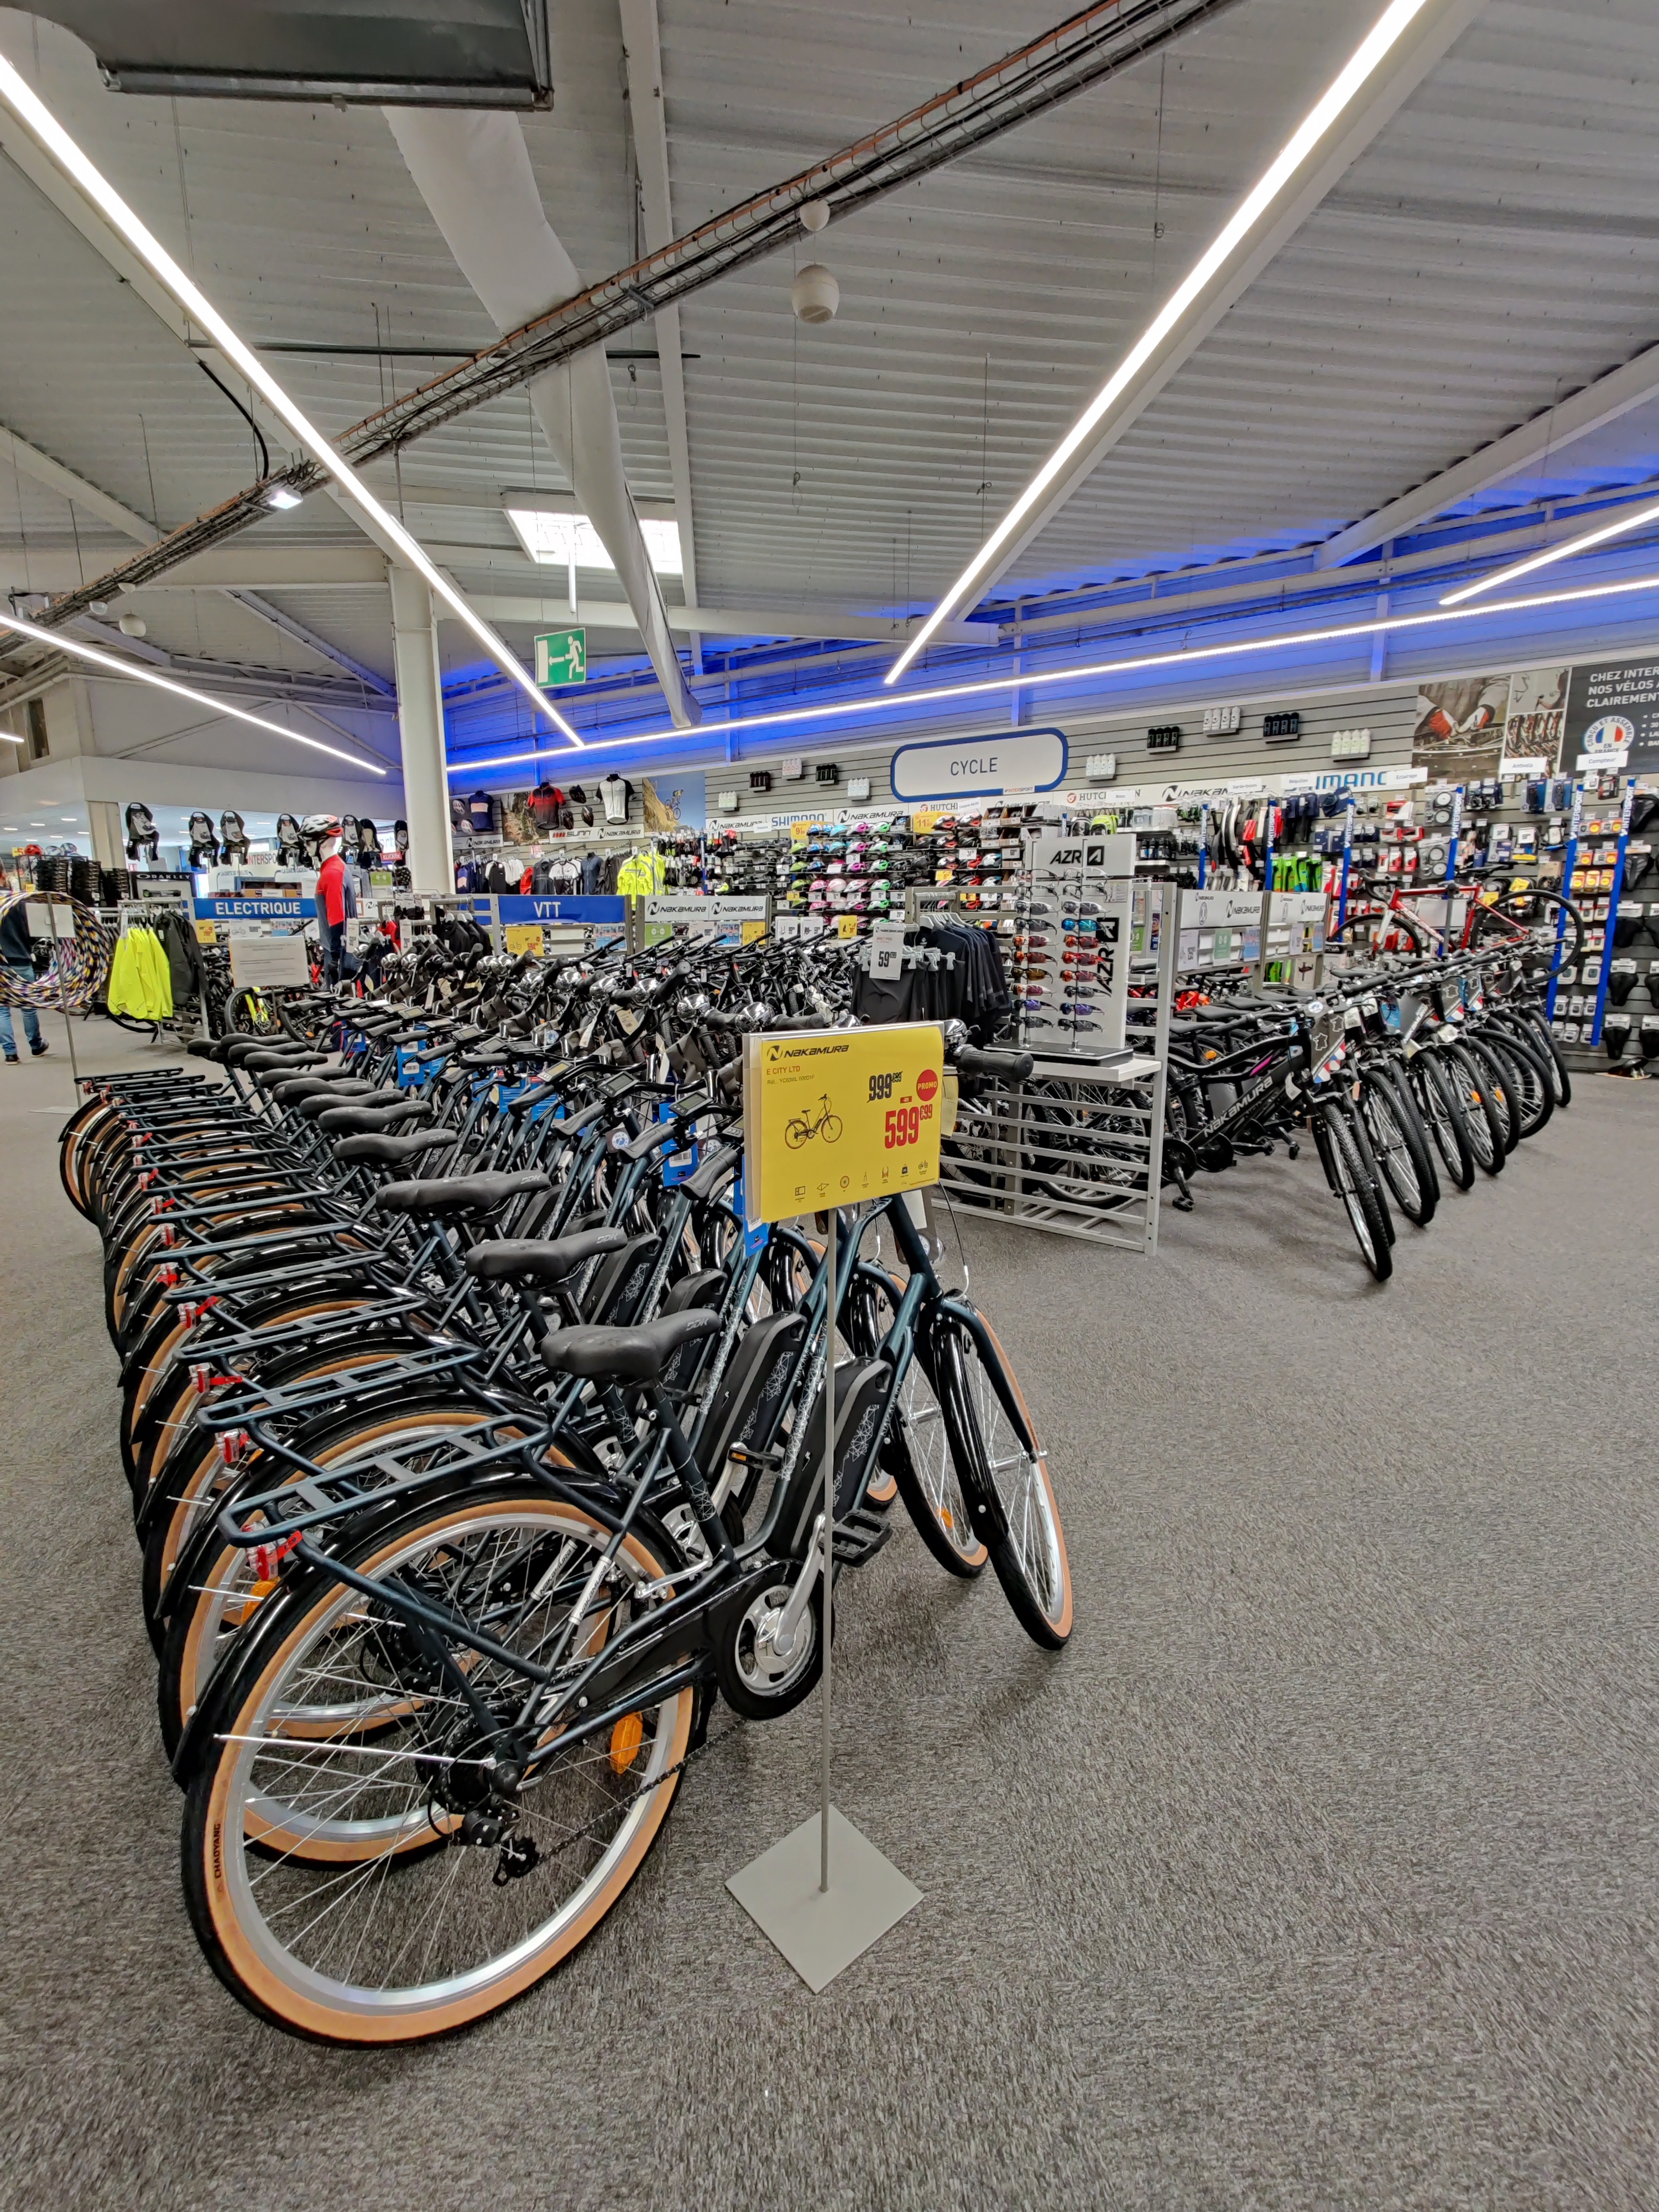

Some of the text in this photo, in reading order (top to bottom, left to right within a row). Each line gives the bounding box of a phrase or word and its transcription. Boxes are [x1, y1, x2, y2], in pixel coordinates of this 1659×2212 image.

[1588, 680, 1653, 695] NOS VÉLOS
[1590, 671, 1621, 682] CHEZ
[951, 757, 998, 775] CYCLE
[1345, 804, 1354, 840] INTERSPORT
[1452, 793, 1463, 832] INTERSPORT
[1571, 791, 1583, 832] INTERSPORT
[1621, 786, 1634, 829] INTERSPORT
[1050, 849, 1082, 865] AZR
[215, 902, 301, 915] ELECTRIQUE
[534, 901, 561, 918] VTT
[1097, 947, 1114, 994] AZR
[784, 1045, 849, 1058] NAKAMURA
[917, 1081, 937, 1091] PROMO
[1203, 1076, 1273, 1138] NAKAMURA
[880, 1381, 903, 1437] NAKAMURA
[540, 1549, 572, 1595] NAKAMURA
[579, 1565, 607, 1617] NAKAMURA
[213, 1823, 222, 1880] CHAOYANG
